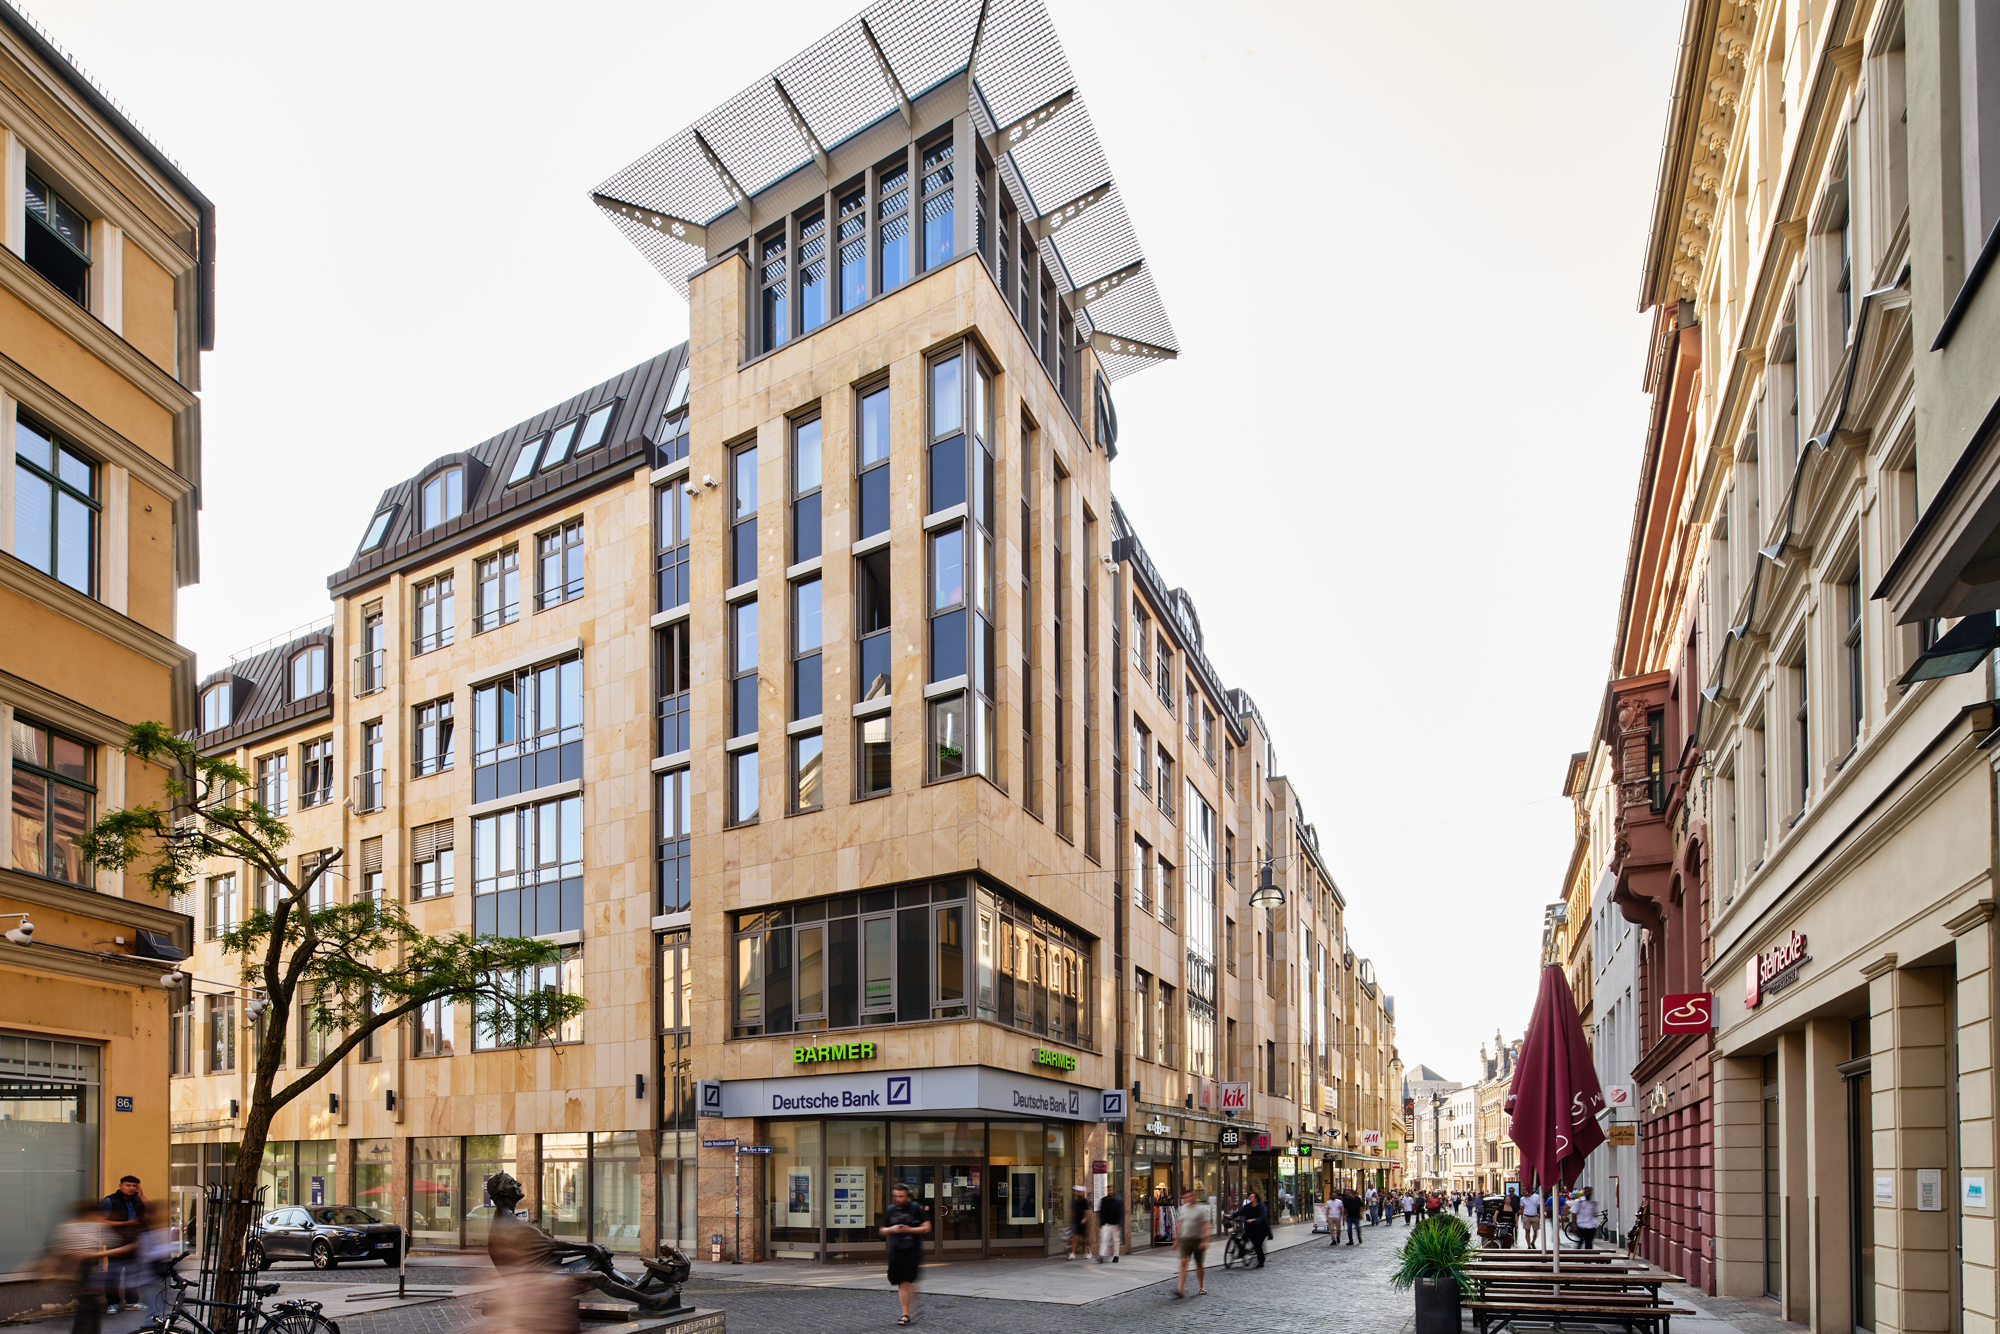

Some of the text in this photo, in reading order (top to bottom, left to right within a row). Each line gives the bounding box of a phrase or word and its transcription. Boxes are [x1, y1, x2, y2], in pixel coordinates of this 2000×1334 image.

[1760, 930, 1803, 984] steinecke
[867, 984, 890, 992] BARMER
[793, 1042, 874, 1063] BARMER
[1039, 1048, 1076, 1071] BARMER
[117, 1098, 130, 1108] 86
[773, 1090, 880, 1110] Deutsche Bank
[1013, 1090, 1067, 1113] Deutsche Bank
[1405, 1114, 1413, 1141] SATURN
